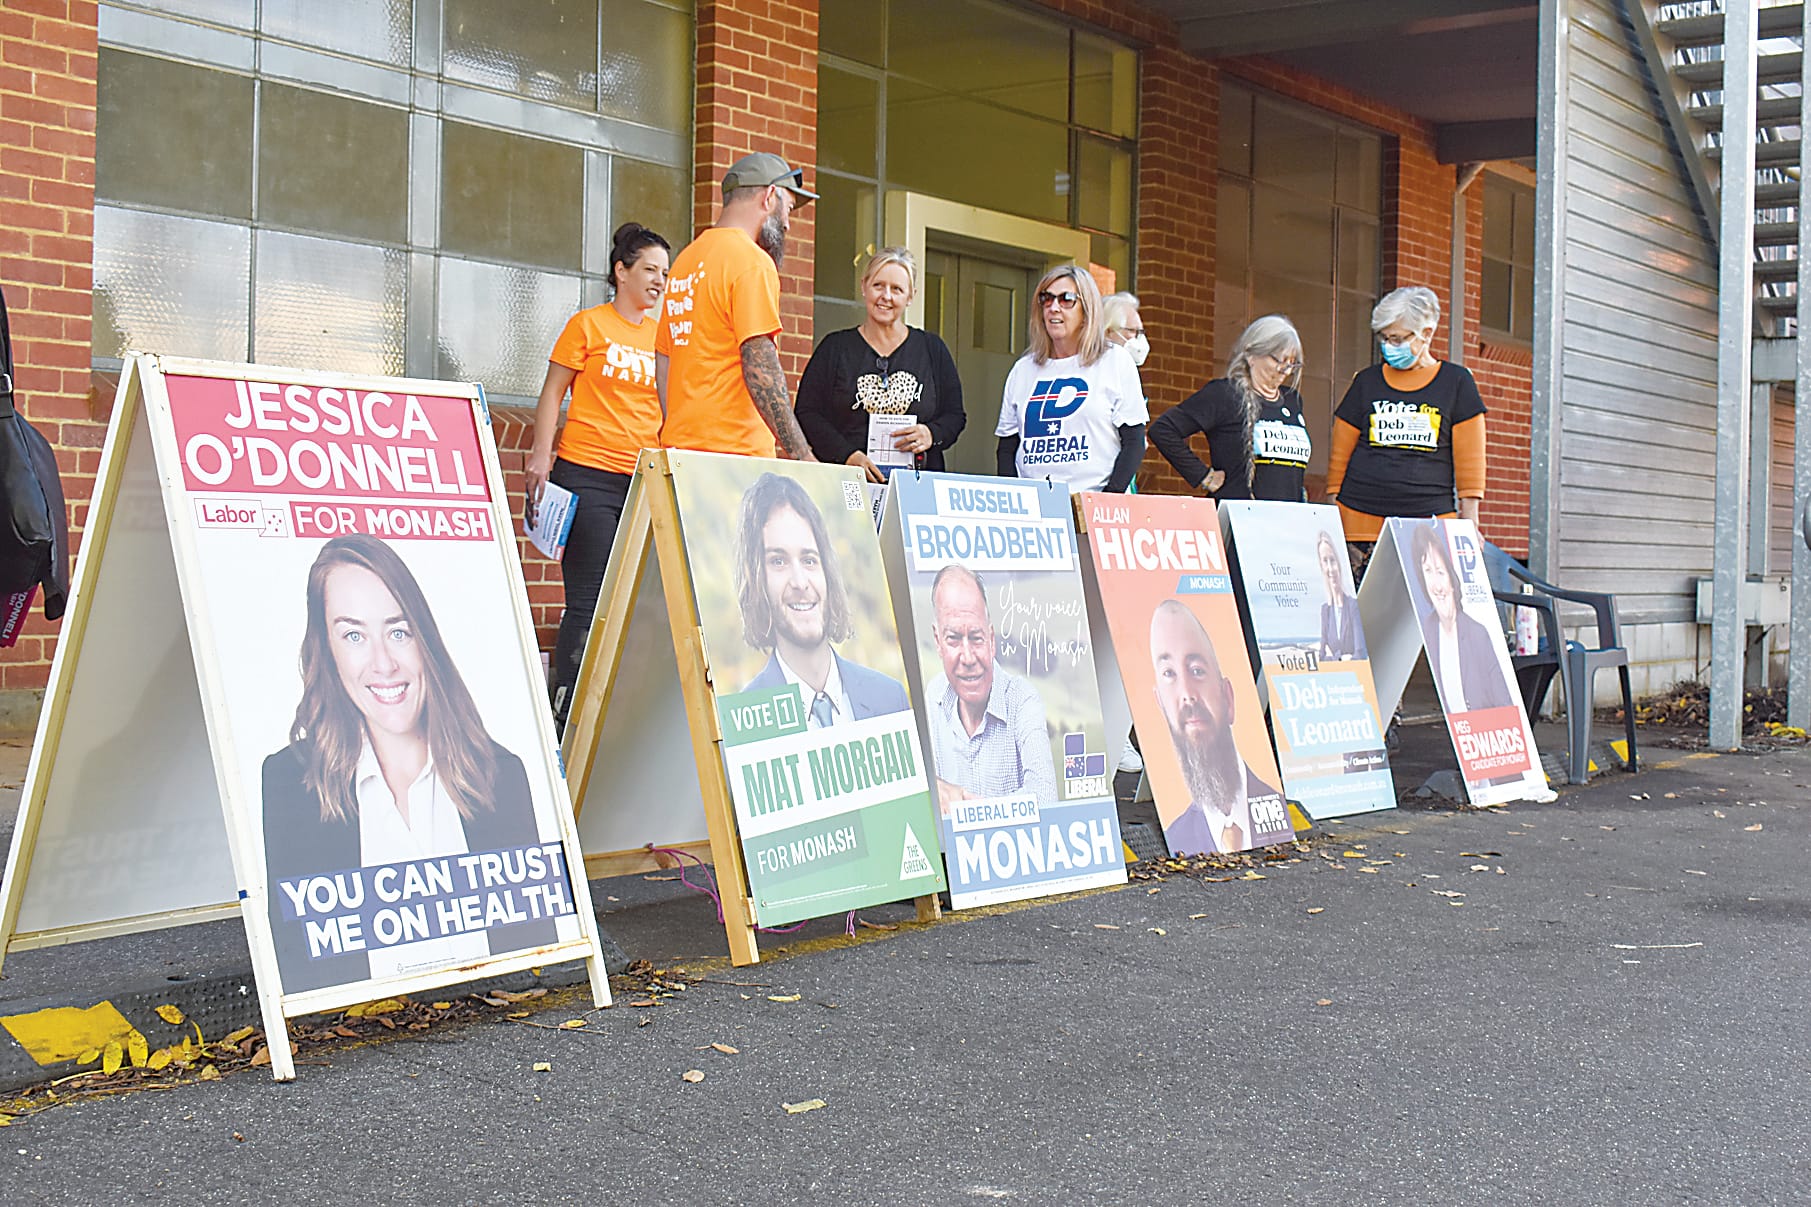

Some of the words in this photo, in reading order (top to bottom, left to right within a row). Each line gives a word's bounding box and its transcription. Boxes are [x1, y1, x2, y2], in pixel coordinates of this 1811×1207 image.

[606, 342, 656, 378] on
[602, 364, 657, 389] NATI
[225, 380, 438, 441] JESSICA
[1372, 400, 1418, 414] Vote
[1419, 403, 1439, 415] for
[1263, 429, 1288, 441] Deb
[1378, 418, 1405, 430] Deb
[1022, 435, 1089, 454] LIBERAL
[1378, 431, 1432, 443] Leonard
[184, 433, 485, 496] O'DONNELL
[1023, 451, 1089, 465] DEMOCRATS
[949, 487, 1028, 515] RUSSELL
[202, 504, 257, 525] Labor
[297, 505, 357, 536] FOR
[368, 508, 489, 538] MONASH
[1092, 507, 1130, 524] ALLAN
[917, 524, 1064, 560] BROADBENT
[1095, 528, 1221, 570] HICKEN
[1270, 562, 1291, 576] Your
[1189, 577, 1226, 590] MONASH
[1258, 578, 1308, 595] Community
[1000, 580, 1041, 639] Your
[1045, 598, 1081, 618] voice
[1274, 594, 1300, 608] Voice
[1000, 641, 1017, 656] in
[1020, 620, 1088, 677] Monash
[1276, 653, 1305, 671] Vote
[1282, 678, 1327, 711] Deb
[731, 704, 771, 732] VOTE
[1288, 709, 1375, 747] Leonard
[1453, 720, 1471, 735] MEG
[1458, 727, 1525, 761] EDWARDS
[742, 754, 804, 818] MAT
[807, 729, 917, 801] MORGAN
[1065, 778, 1108, 799] LIBERAL
[956, 806, 1008, 824] LIBERAL
[1010, 802, 1036, 818] FOR
[1250, 799, 1285, 825] one
[1254, 819, 1289, 834] NATION
[757, 845, 791, 874] FOR
[790, 825, 857, 866] MONASH
[906, 845, 918, 857] THE
[955, 819, 1114, 884] MONASH
[904, 859, 928, 874] GREENS
[281, 873, 364, 916] YOU
[374, 860, 454, 902] CAN
[459, 844, 562, 890] TRUST
[306, 912, 366, 958] ME
[372, 905, 430, 946] ON
[437, 882, 574, 935] HEALTH.
